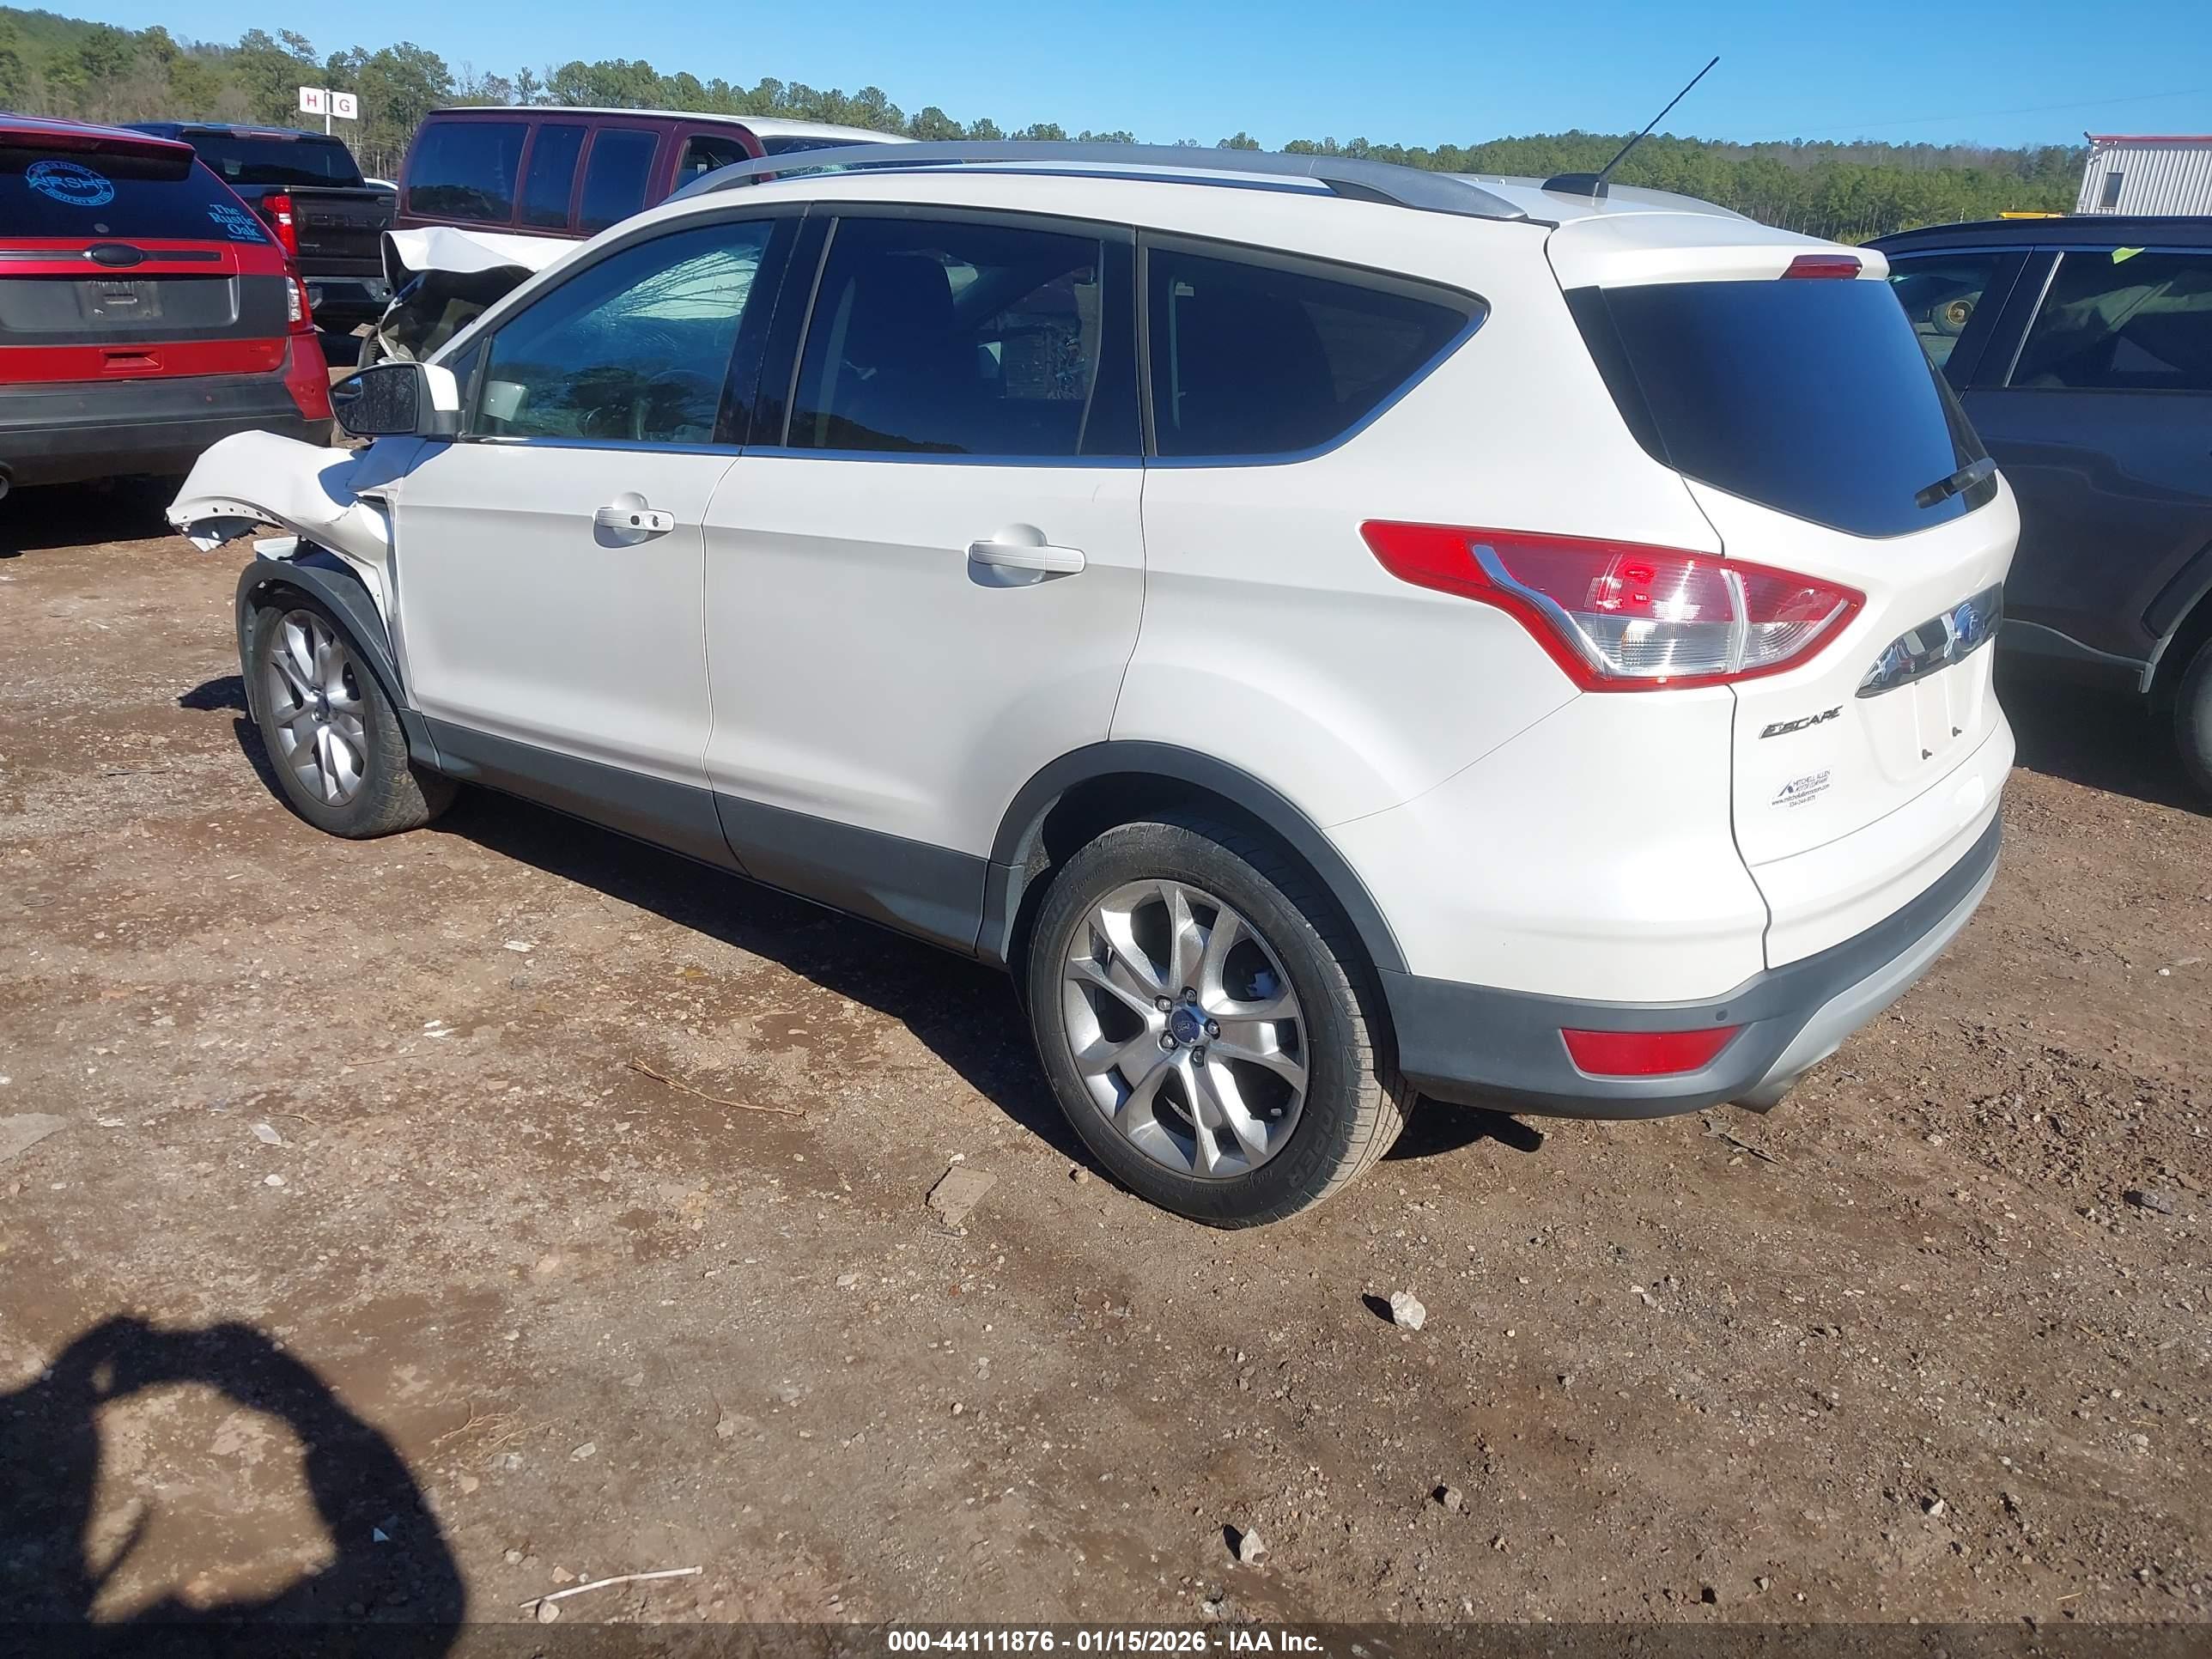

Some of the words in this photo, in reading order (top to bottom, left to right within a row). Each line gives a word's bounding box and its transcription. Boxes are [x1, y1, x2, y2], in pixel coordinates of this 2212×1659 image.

[307, 94, 317, 107] H
[338, 99, 350, 112] G
[210, 204, 240, 216] The
[207, 212, 257, 226] Rustic
[227, 223, 260, 237] Oak
[1758, 705, 1844, 739] ESCAPE
[1793, 775, 1815, 787] MITCHELL
[1817, 769, 1831, 779] ALLEN
